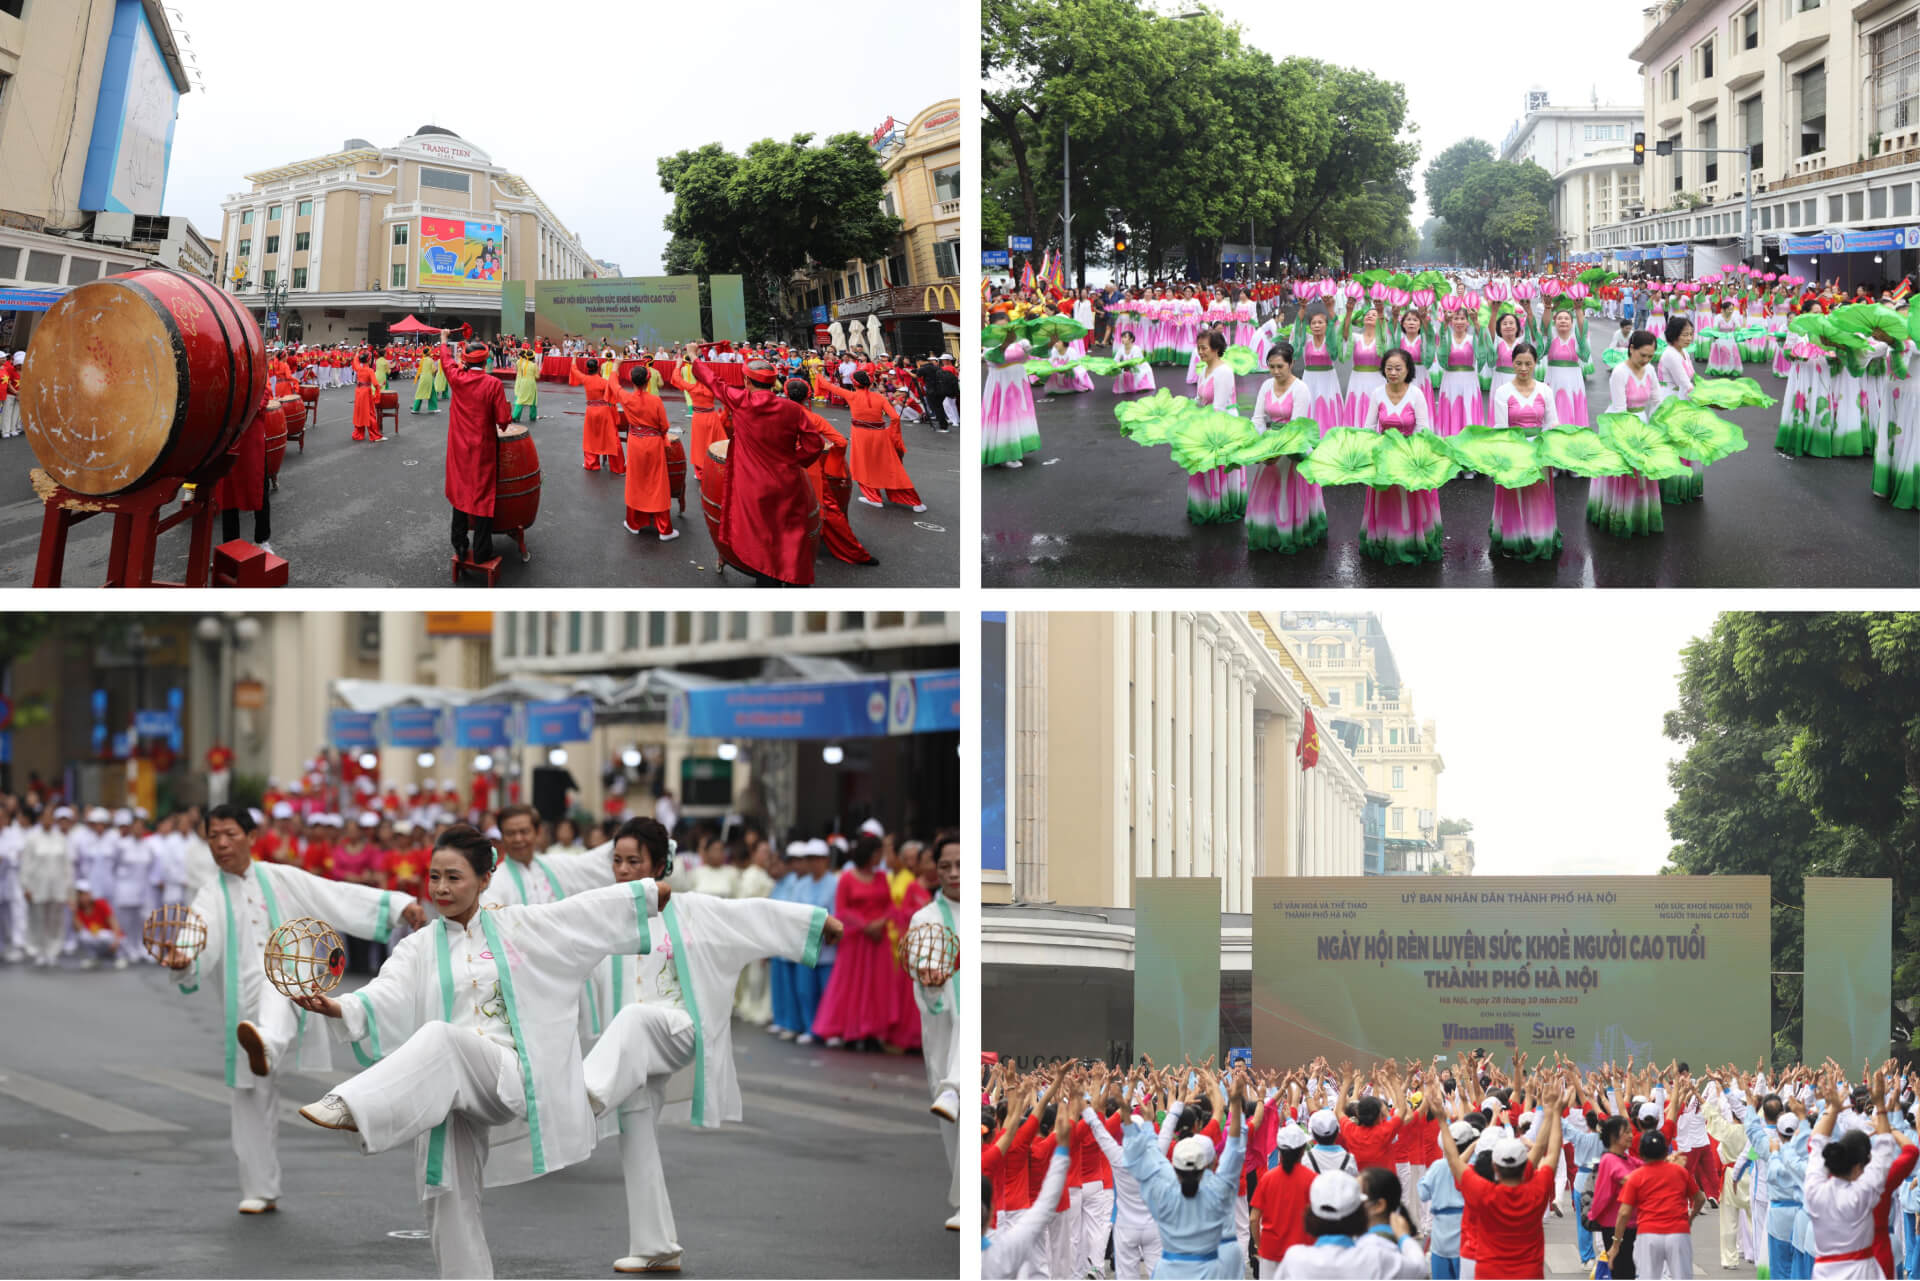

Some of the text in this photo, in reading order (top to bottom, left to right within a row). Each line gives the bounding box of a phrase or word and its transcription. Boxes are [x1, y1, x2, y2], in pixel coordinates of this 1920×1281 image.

[421, 143, 449, 154] TRANG
[1420, 893, 1442, 904] BAN
[1445, 891, 1478, 904] NHÂN
[1481, 891, 1505, 904] DÂN
[1508, 891, 1548, 904] THÀNH
[1551, 889, 1575, 904] PHỐ
[1577, 891, 1594, 904] HÀ
[1597, 890, 1617, 906] NỘI
[1285, 910, 1311, 919] THÀNH
[1312, 910, 1328, 919] PHỐ
[1317, 929, 1361, 960] NGÀY
[1364, 929, 1393, 968] HỘI
[1397, 929, 1429, 960] RÈN
[1433, 929, 1486, 968] LUYỆN
[1489, 928, 1522, 960] SỨC
[1573, 928, 1627, 960] NGƯỜI
[1630, 935, 1664, 960] CAO
[1666, 923, 1706, 960] TUỔI
[1424, 961, 1599, 994] THÀNH PHỐ HÀ NỘI
[1441, 1022, 1576, 1041] Vinamilk Sure
